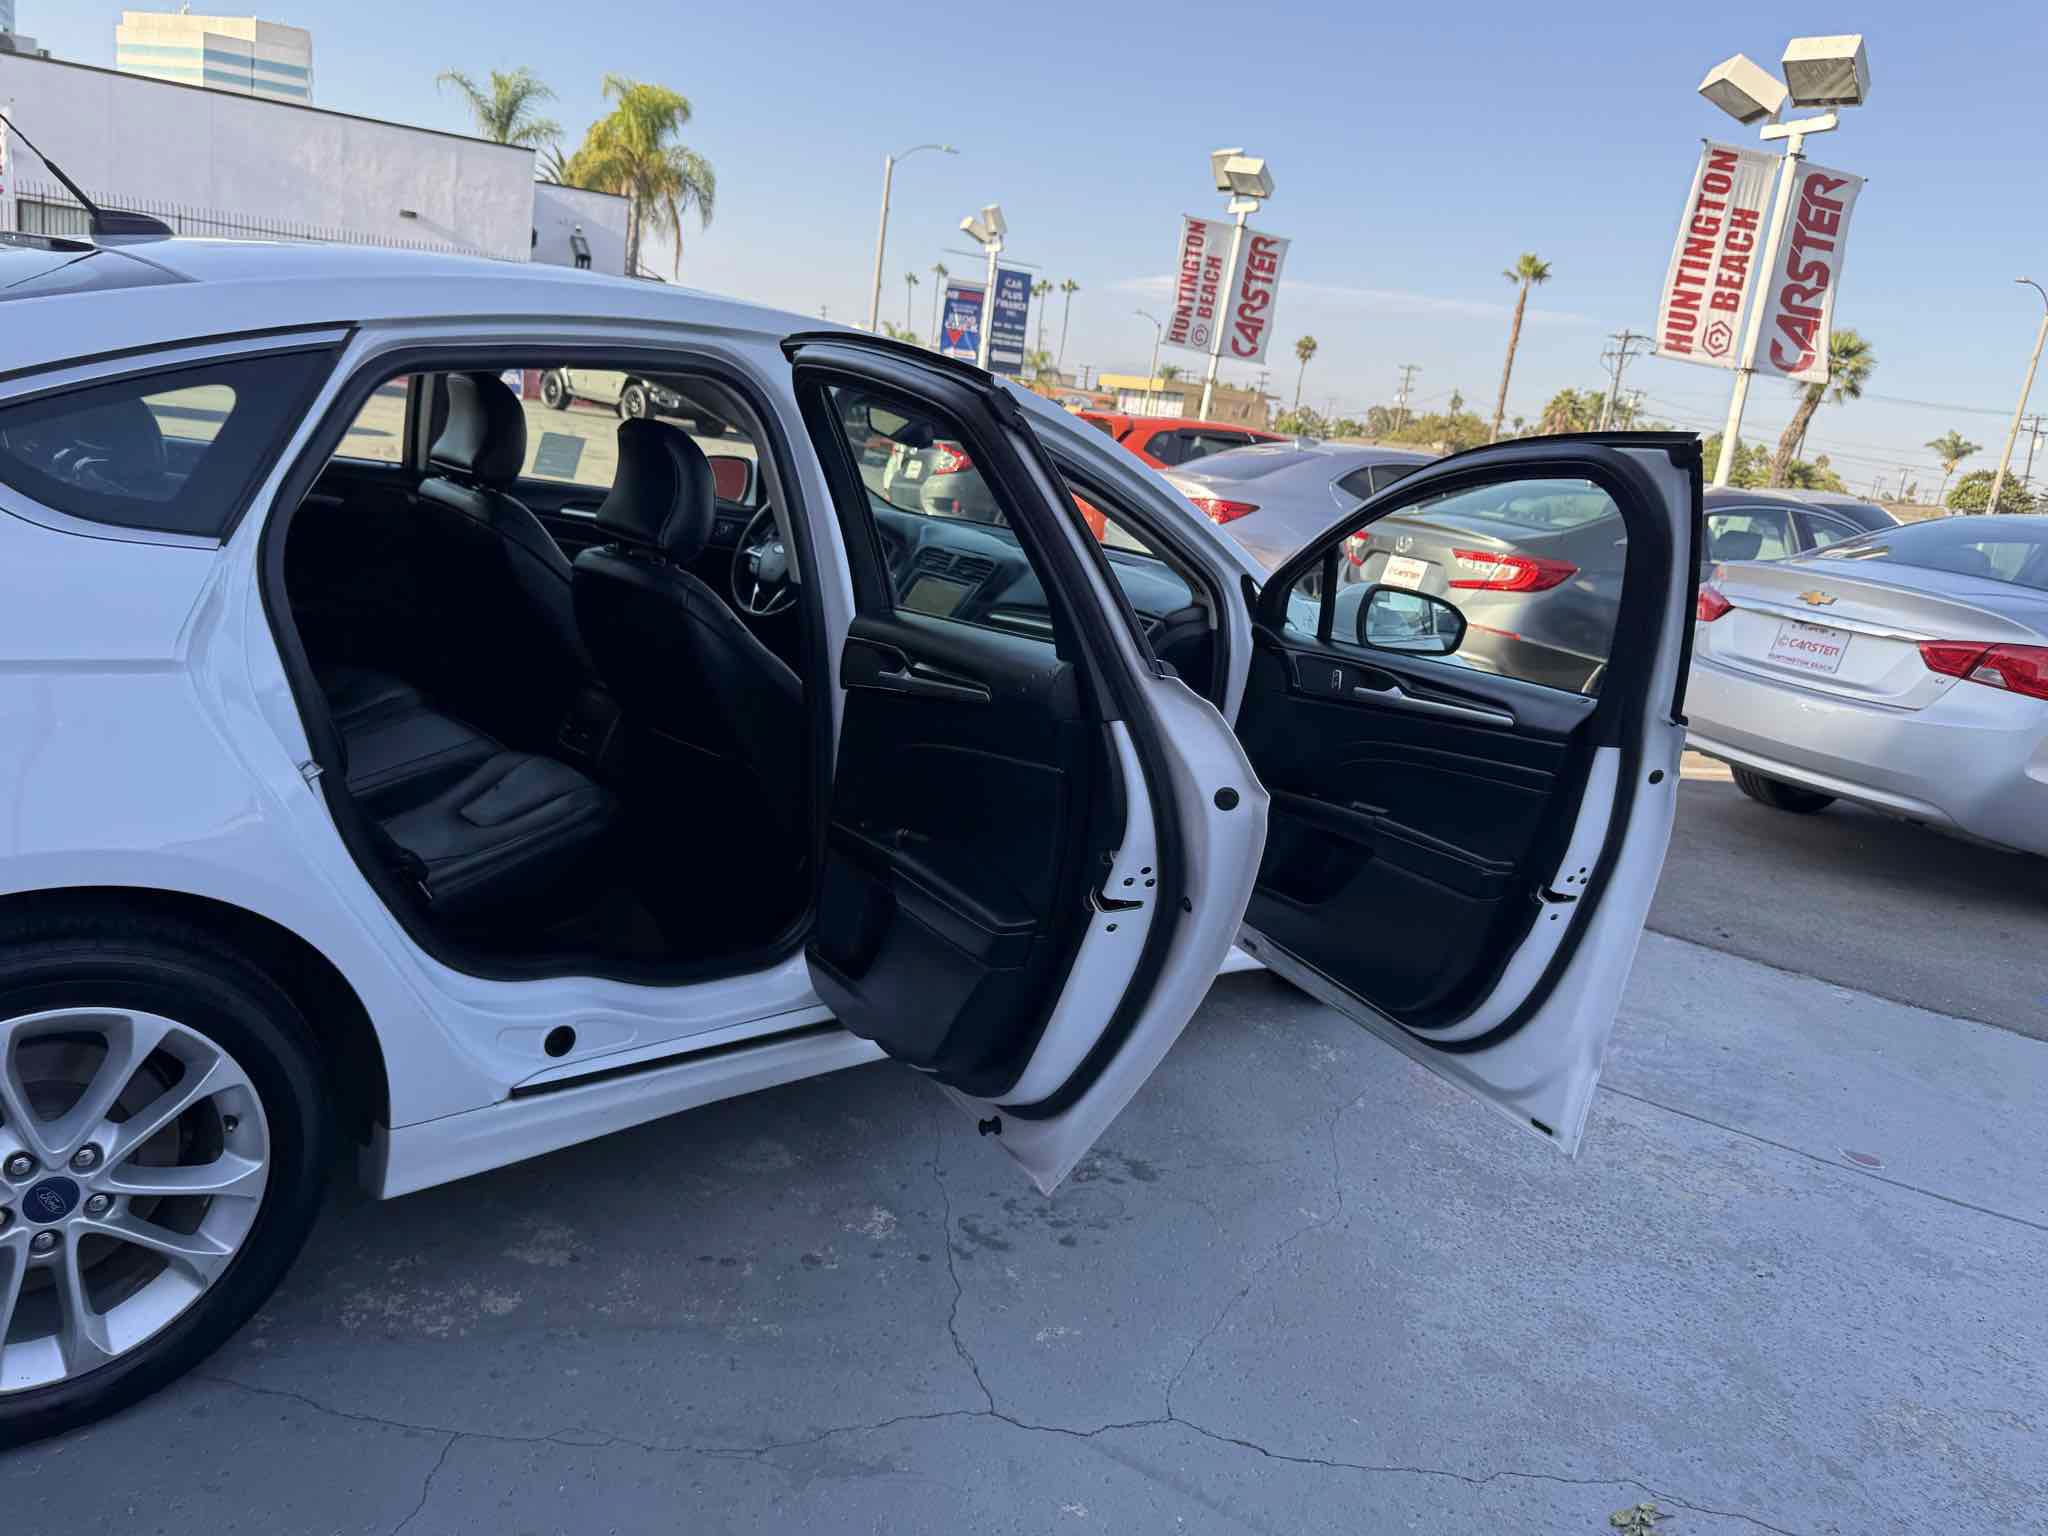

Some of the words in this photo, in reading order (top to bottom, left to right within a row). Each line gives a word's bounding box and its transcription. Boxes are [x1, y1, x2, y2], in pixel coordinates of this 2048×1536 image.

[1169, 220, 1207, 344] HUNTINGTON
[1196, 256, 1223, 319] BEACH
[1231, 236, 1280, 357] CARSTER
[1664, 148, 1739, 355] HUNTINGTON
[1710, 207, 1760, 313] BEACH
[1769, 172, 1849, 373] CARSTER
[1789, 638, 1840, 657] CARSTER
